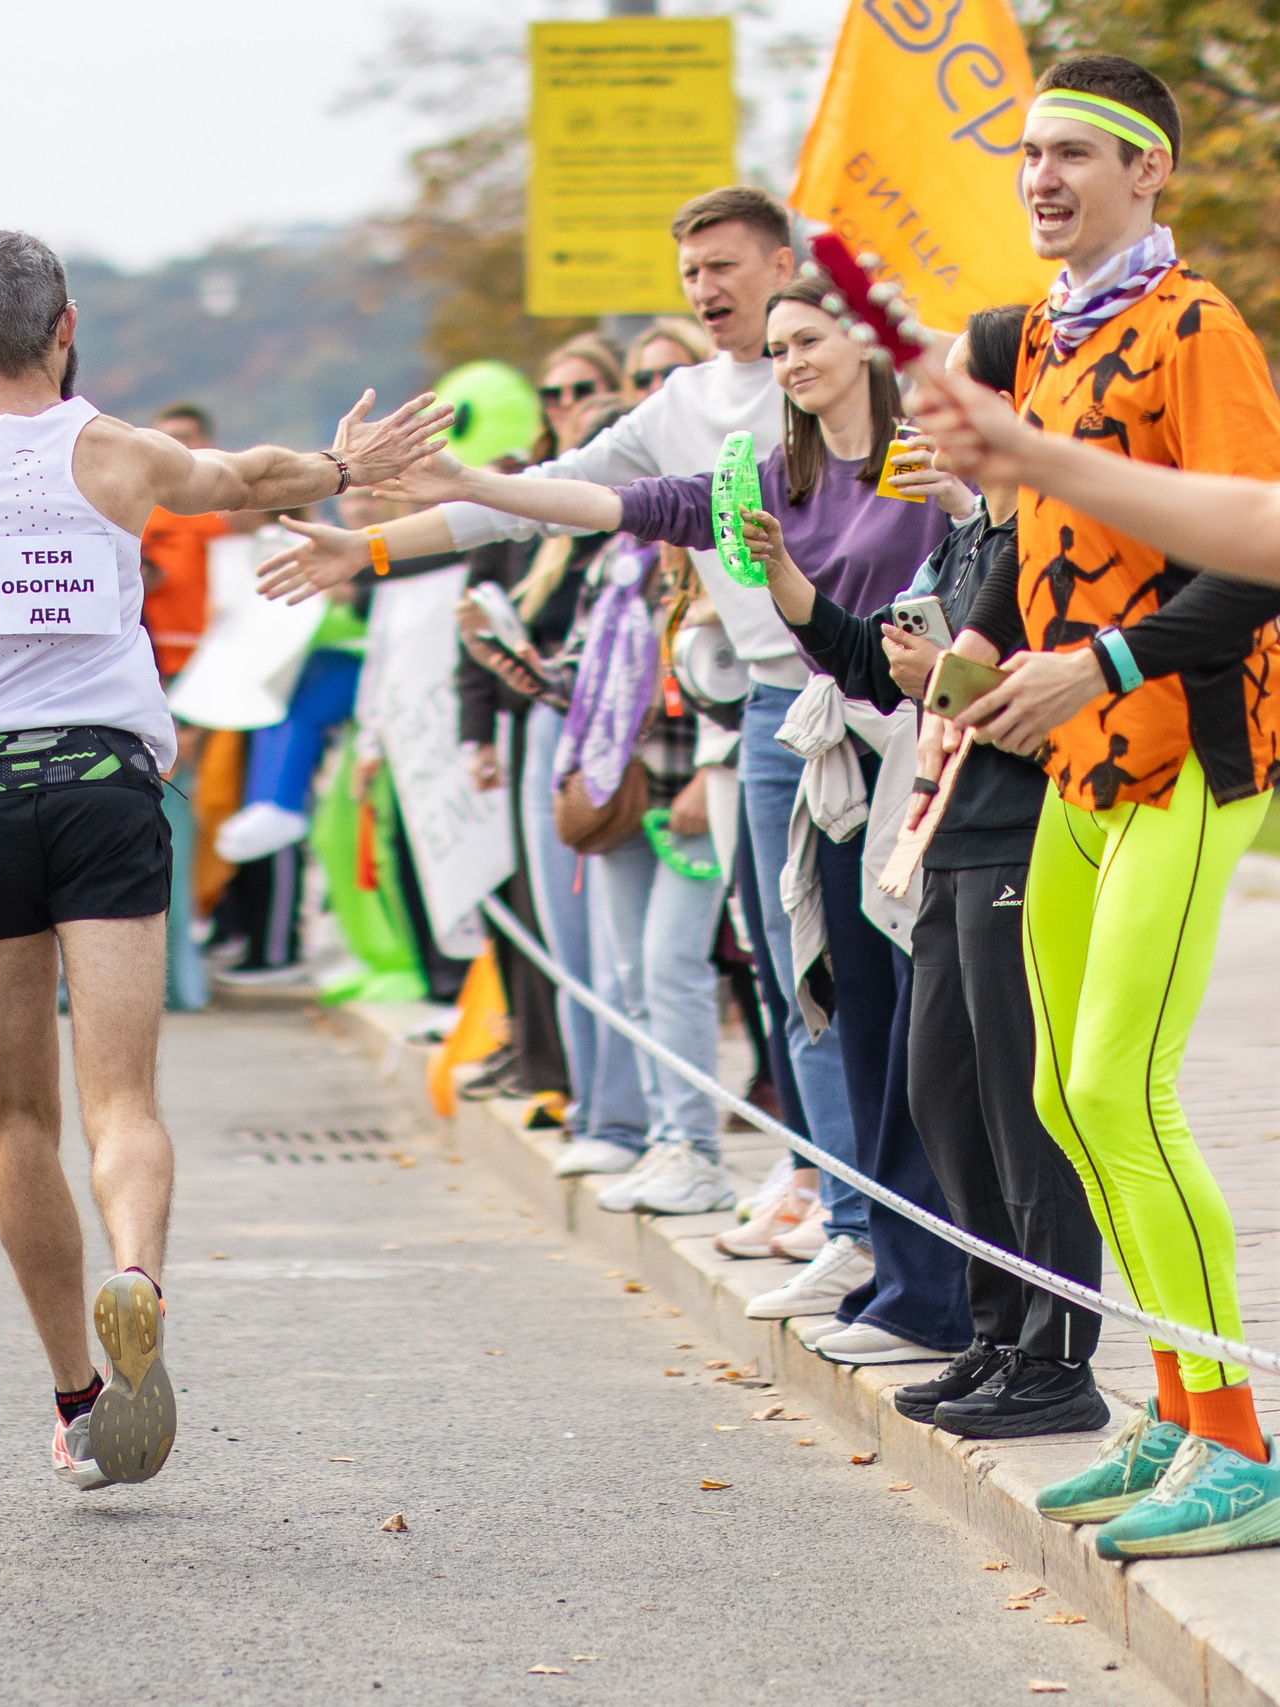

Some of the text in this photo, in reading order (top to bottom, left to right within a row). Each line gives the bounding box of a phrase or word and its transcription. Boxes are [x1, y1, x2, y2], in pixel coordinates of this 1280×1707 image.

[844, 152, 960, 292] БИТЦА
[21, 550, 73, 565] ТЕБЯ
[1, 579, 95, 594] ОБОГНАЛ
[30, 608, 71, 624] ДЕД
